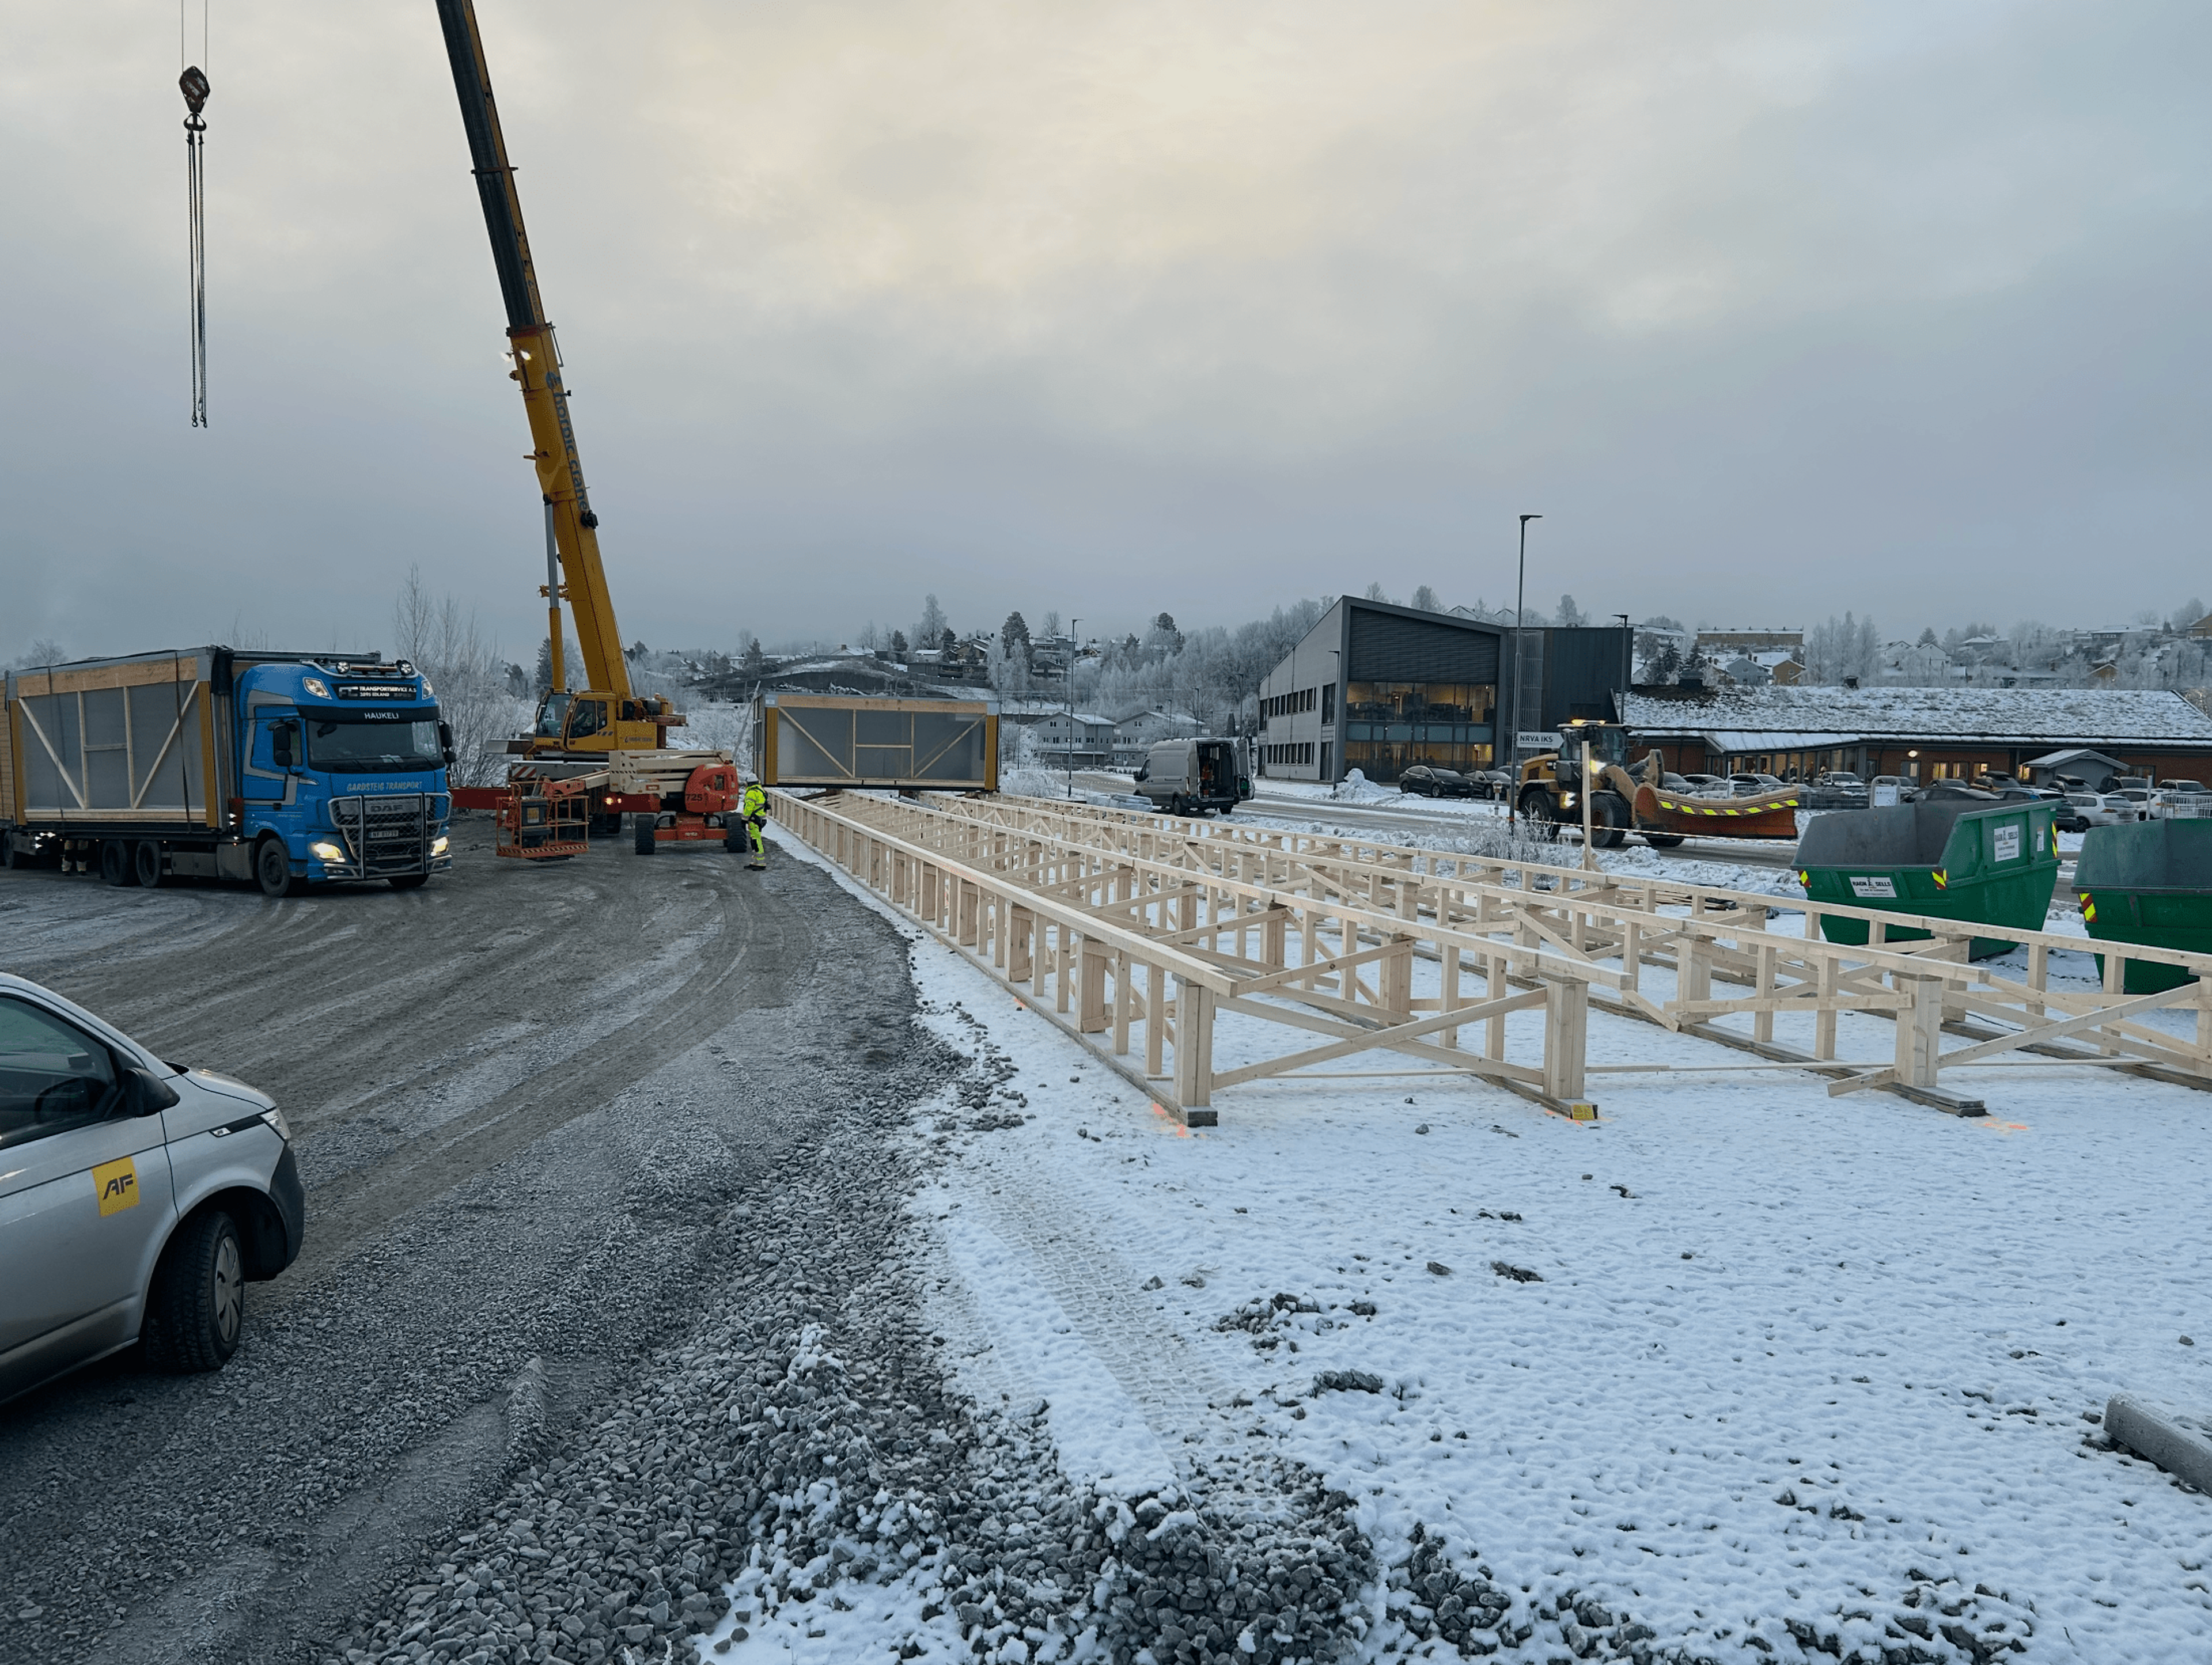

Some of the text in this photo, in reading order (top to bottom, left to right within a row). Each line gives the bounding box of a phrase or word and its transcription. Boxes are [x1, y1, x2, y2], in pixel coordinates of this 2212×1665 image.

[570, 460, 588, 510] crane
[347, 781, 423, 792] GARDSTEIG TRANSPORT
[370, 804, 404, 812] DAF
[103, 1173, 133, 1200] AF
